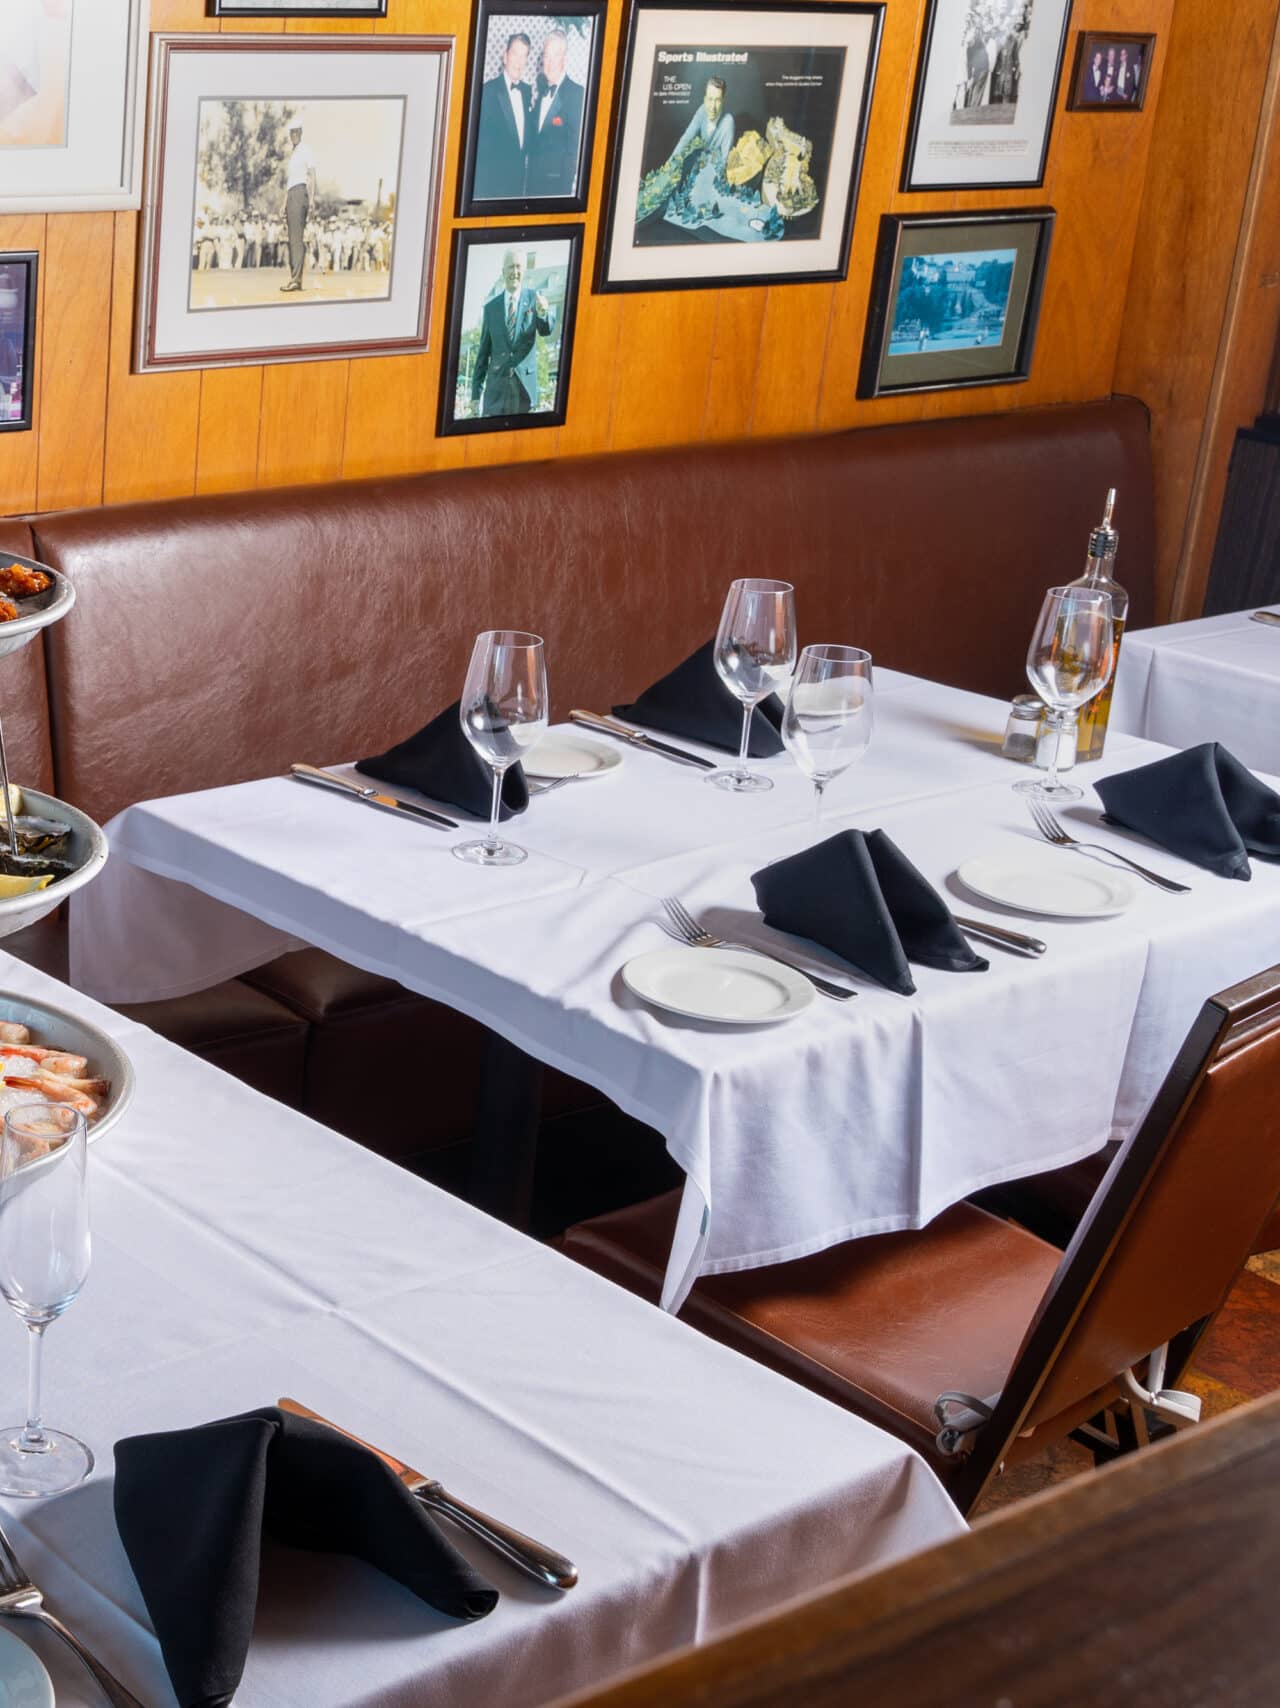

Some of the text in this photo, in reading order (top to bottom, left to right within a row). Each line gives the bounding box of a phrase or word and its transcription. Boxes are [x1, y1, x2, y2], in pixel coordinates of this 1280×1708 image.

[658, 51, 749, 64] Sports Illustrated
[664, 75, 677, 83] THE
[674, 83, 692, 91] OPEN
